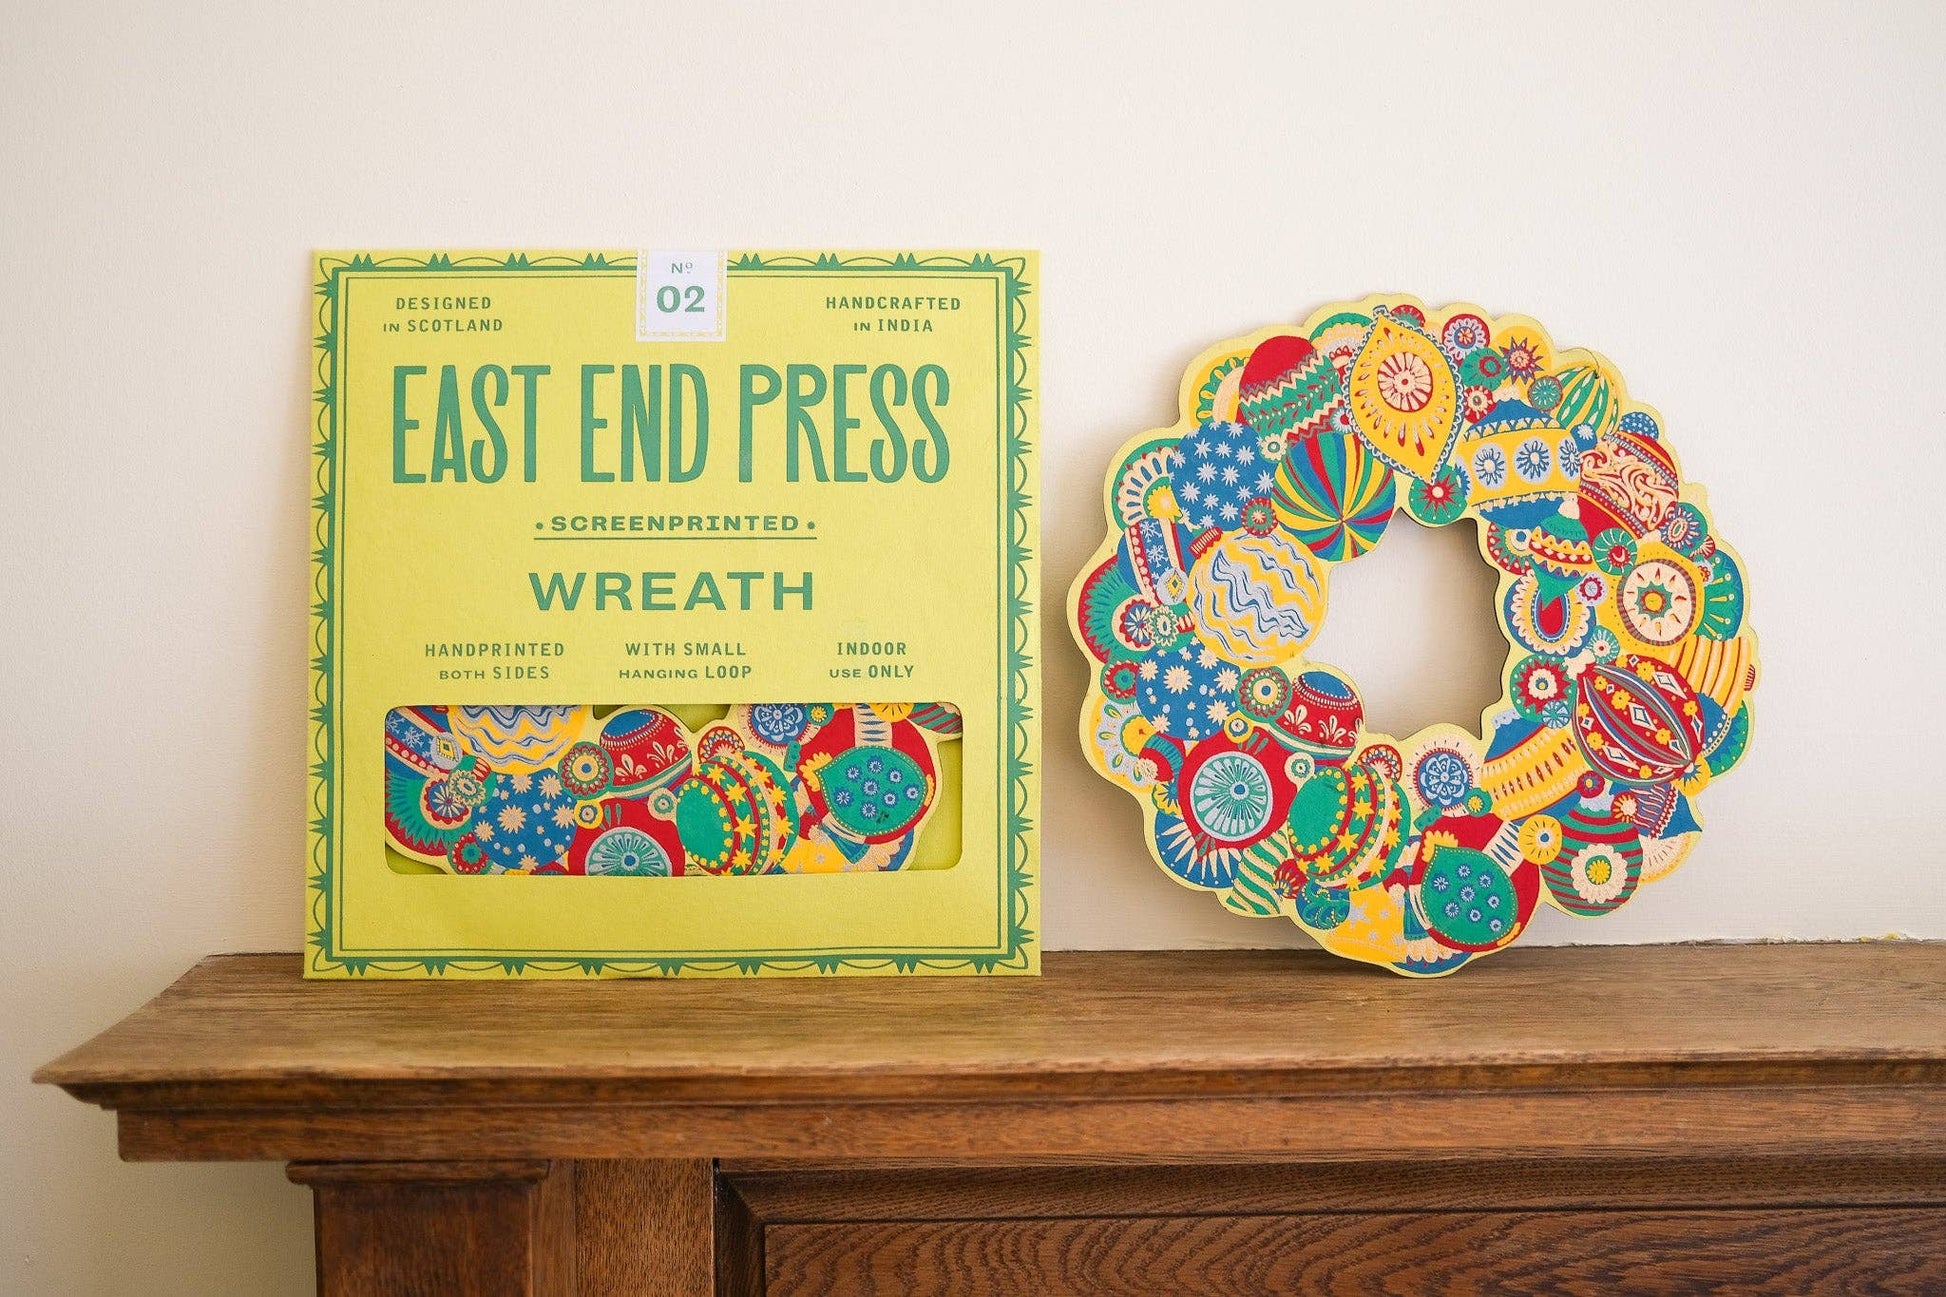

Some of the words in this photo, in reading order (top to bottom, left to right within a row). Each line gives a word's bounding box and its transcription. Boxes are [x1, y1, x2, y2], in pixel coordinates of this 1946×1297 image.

[396, 296, 491, 310] DESIGNED
[656, 285, 705, 313] 02
[826, 296, 961, 310] HANDCRAFTED
[407, 319, 503, 332] SCOTLAND
[878, 319, 933, 332] INDIA
[393, 364, 551, 484] EAST
[581, 364, 709, 484] END
[739, 364, 950, 484] PRESS
[551, 515, 799, 532] SCREENPRINTED
[529, 572, 813, 611] WREATH
[425, 642, 564, 656] HANDPRINTED
[625, 642, 676, 656] WITH
[683, 642, 746, 656] SMALL
[837, 641, 907, 655] INDOOR
[439, 670, 484, 680] BOTH
[492, 666, 549, 679] SIDES
[619, 669, 698, 679] HANGING
[705, 666, 752, 679] LOOP
[829, 669, 862, 679] USE
[868, 665, 914, 679] ONLY
